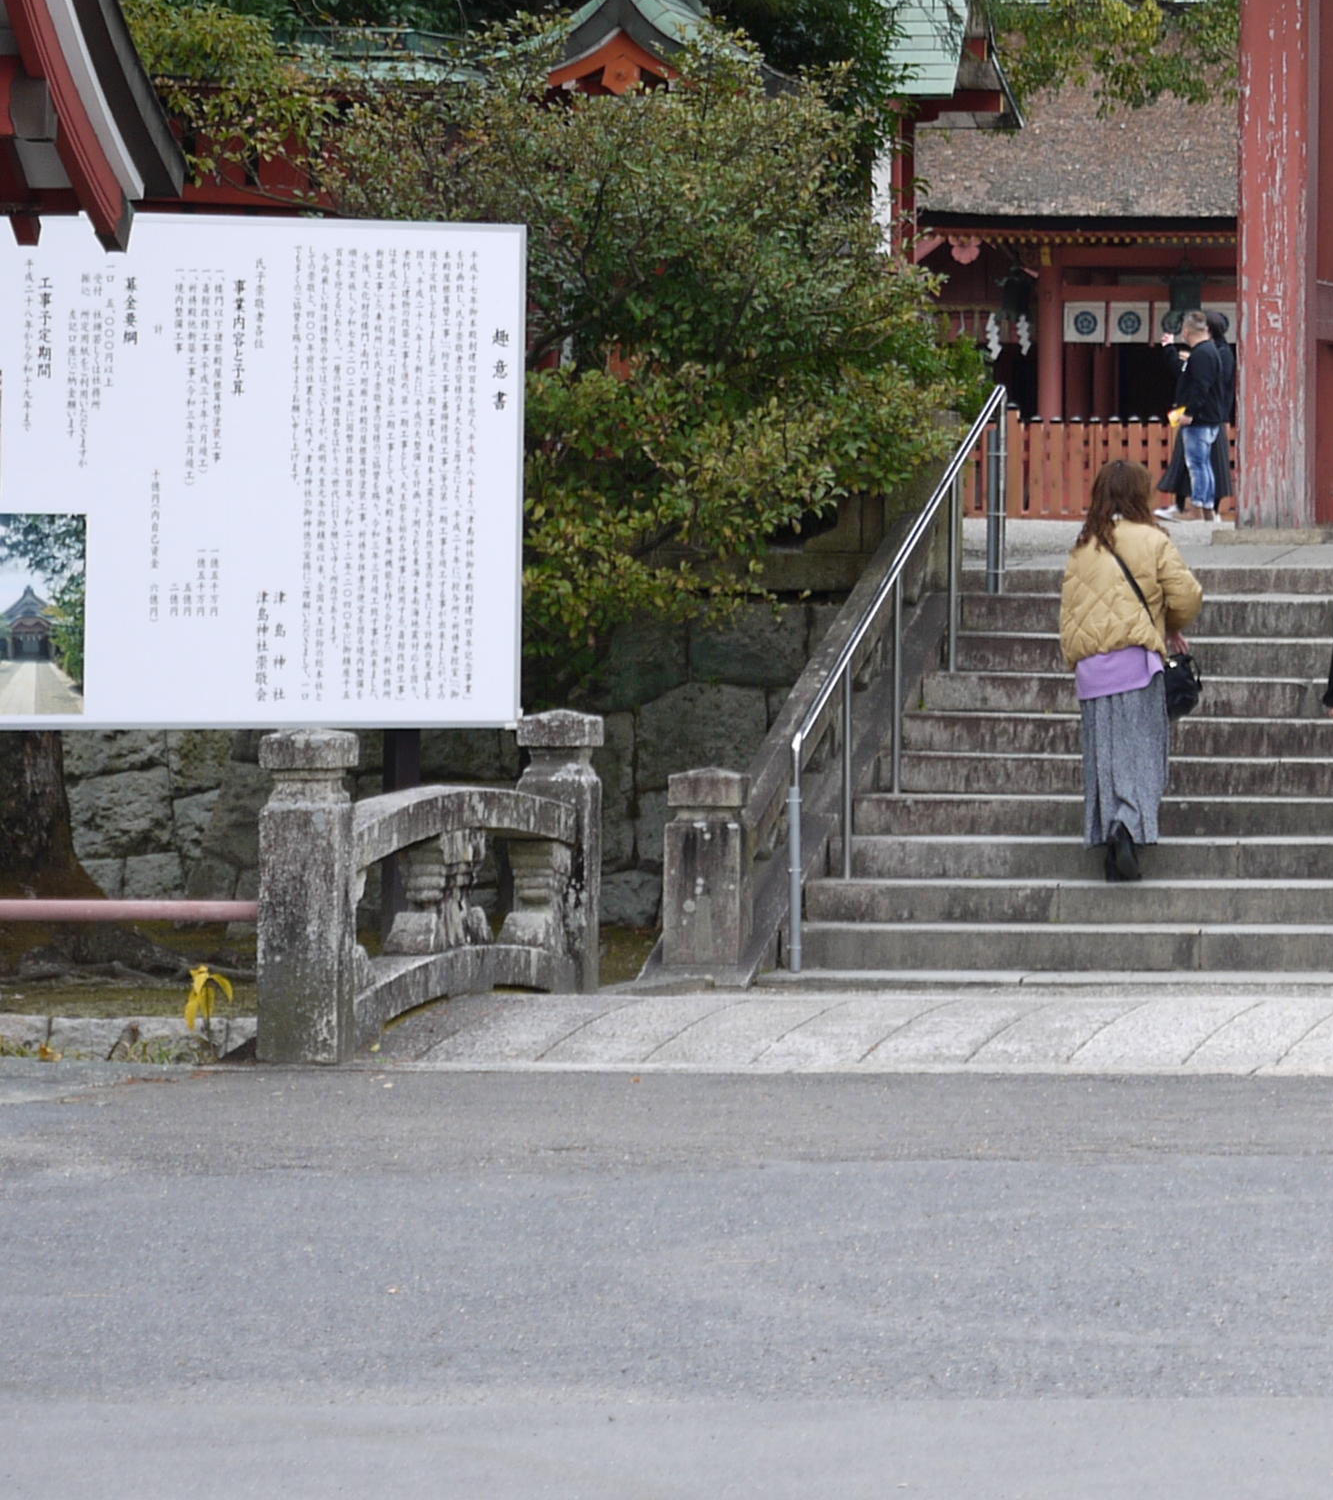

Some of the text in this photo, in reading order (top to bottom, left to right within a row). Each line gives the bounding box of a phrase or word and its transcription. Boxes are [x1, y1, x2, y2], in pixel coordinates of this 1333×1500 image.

[37, 277, 53, 379] 工事予定期間
[123, 276, 138, 345] 募金要綱
[231, 279, 246, 396] 事業内容と予算
[492, 327, 509, 411] 趣意書
[170, 583, 179, 616] 二億円
[183, 582, 192, 617] 五億円
[255, 590, 269, 702] 津島神社崇敬会
